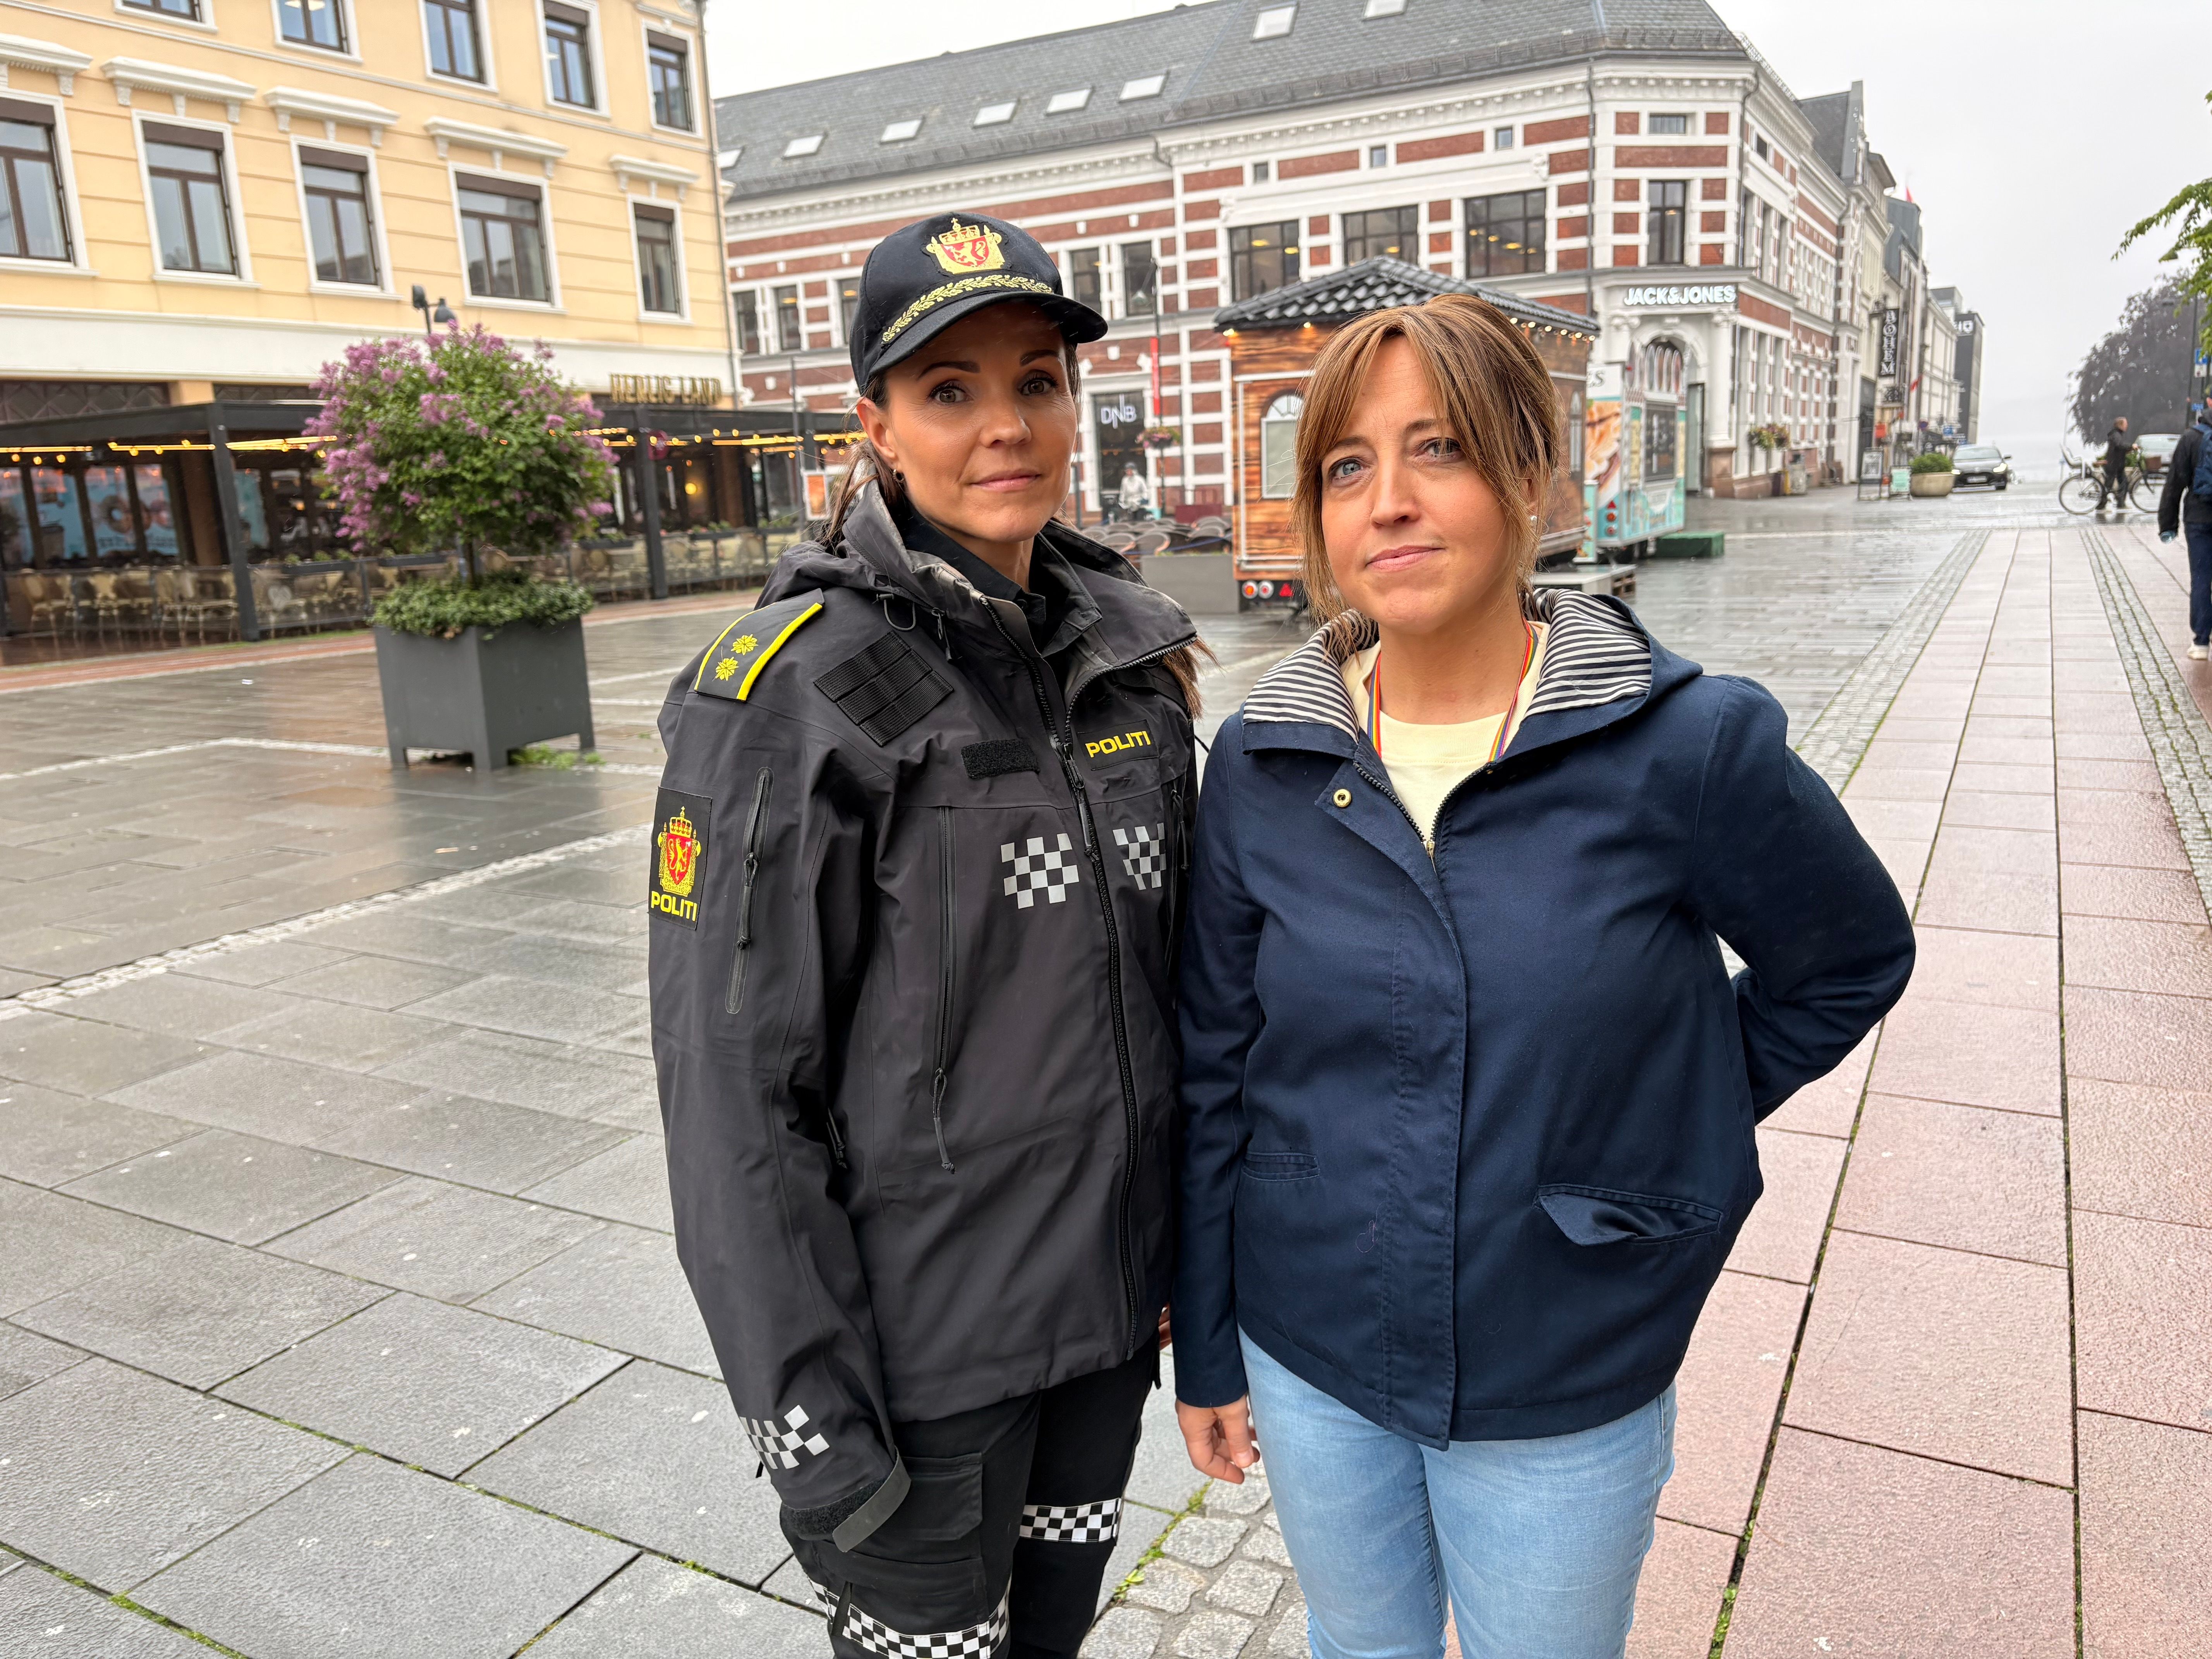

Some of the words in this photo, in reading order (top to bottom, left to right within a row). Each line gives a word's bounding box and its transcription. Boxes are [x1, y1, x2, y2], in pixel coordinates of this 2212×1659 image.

[1624, 285, 1736, 305] JACK&JONES
[1881, 310, 1897, 375] BOHEM
[679, 376, 722, 404] LAND
[1101, 393, 1137, 429] DNB
[1085, 731, 1151, 758] POLITI
[651, 891, 697, 921] POLITI
